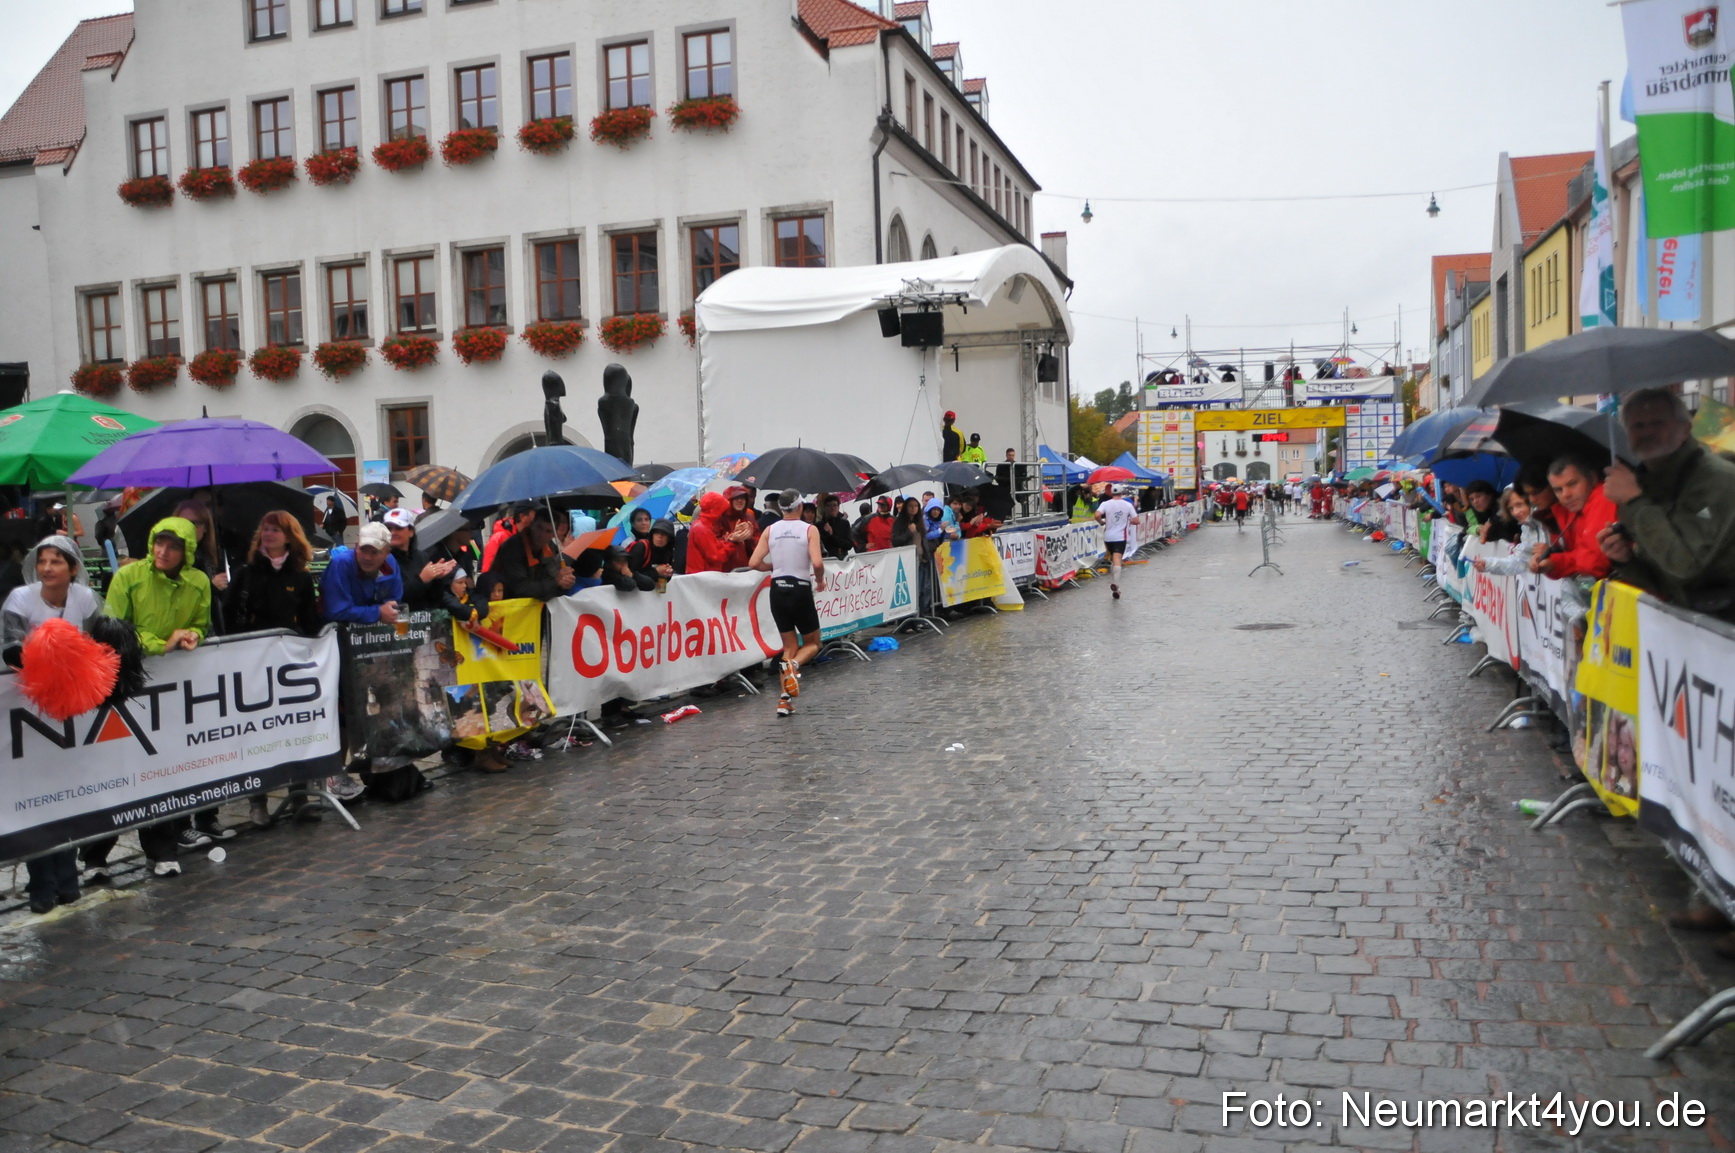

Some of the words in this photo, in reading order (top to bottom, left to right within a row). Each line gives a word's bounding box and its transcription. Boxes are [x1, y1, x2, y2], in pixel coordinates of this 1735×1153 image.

[1157, 387, 1204, 399] BOCK
[1306, 382, 1355, 393] BOCK
[1253, 412, 1287, 425] ZIEL
[350, 633, 362, 645] für
[365, 632, 391, 644] Ihren
[508, 642, 535, 656] ANN
[572, 598, 747, 679] Oberbank
[10, 661, 323, 760] NATHUS
[186, 720, 258, 747] MEDIA
[261, 707, 327, 729] GMBH
[14, 776, 130, 812] INTERNETLÖSUNGEN
[139, 751, 239, 783] SCHULUNGSZENTRUM
[246, 740, 284, 757] KONZEPT
[285, 738, 293, 748] &
[294, 732, 330, 747] DESIGN
[112, 776, 262, 826] www.nathus-media.de
